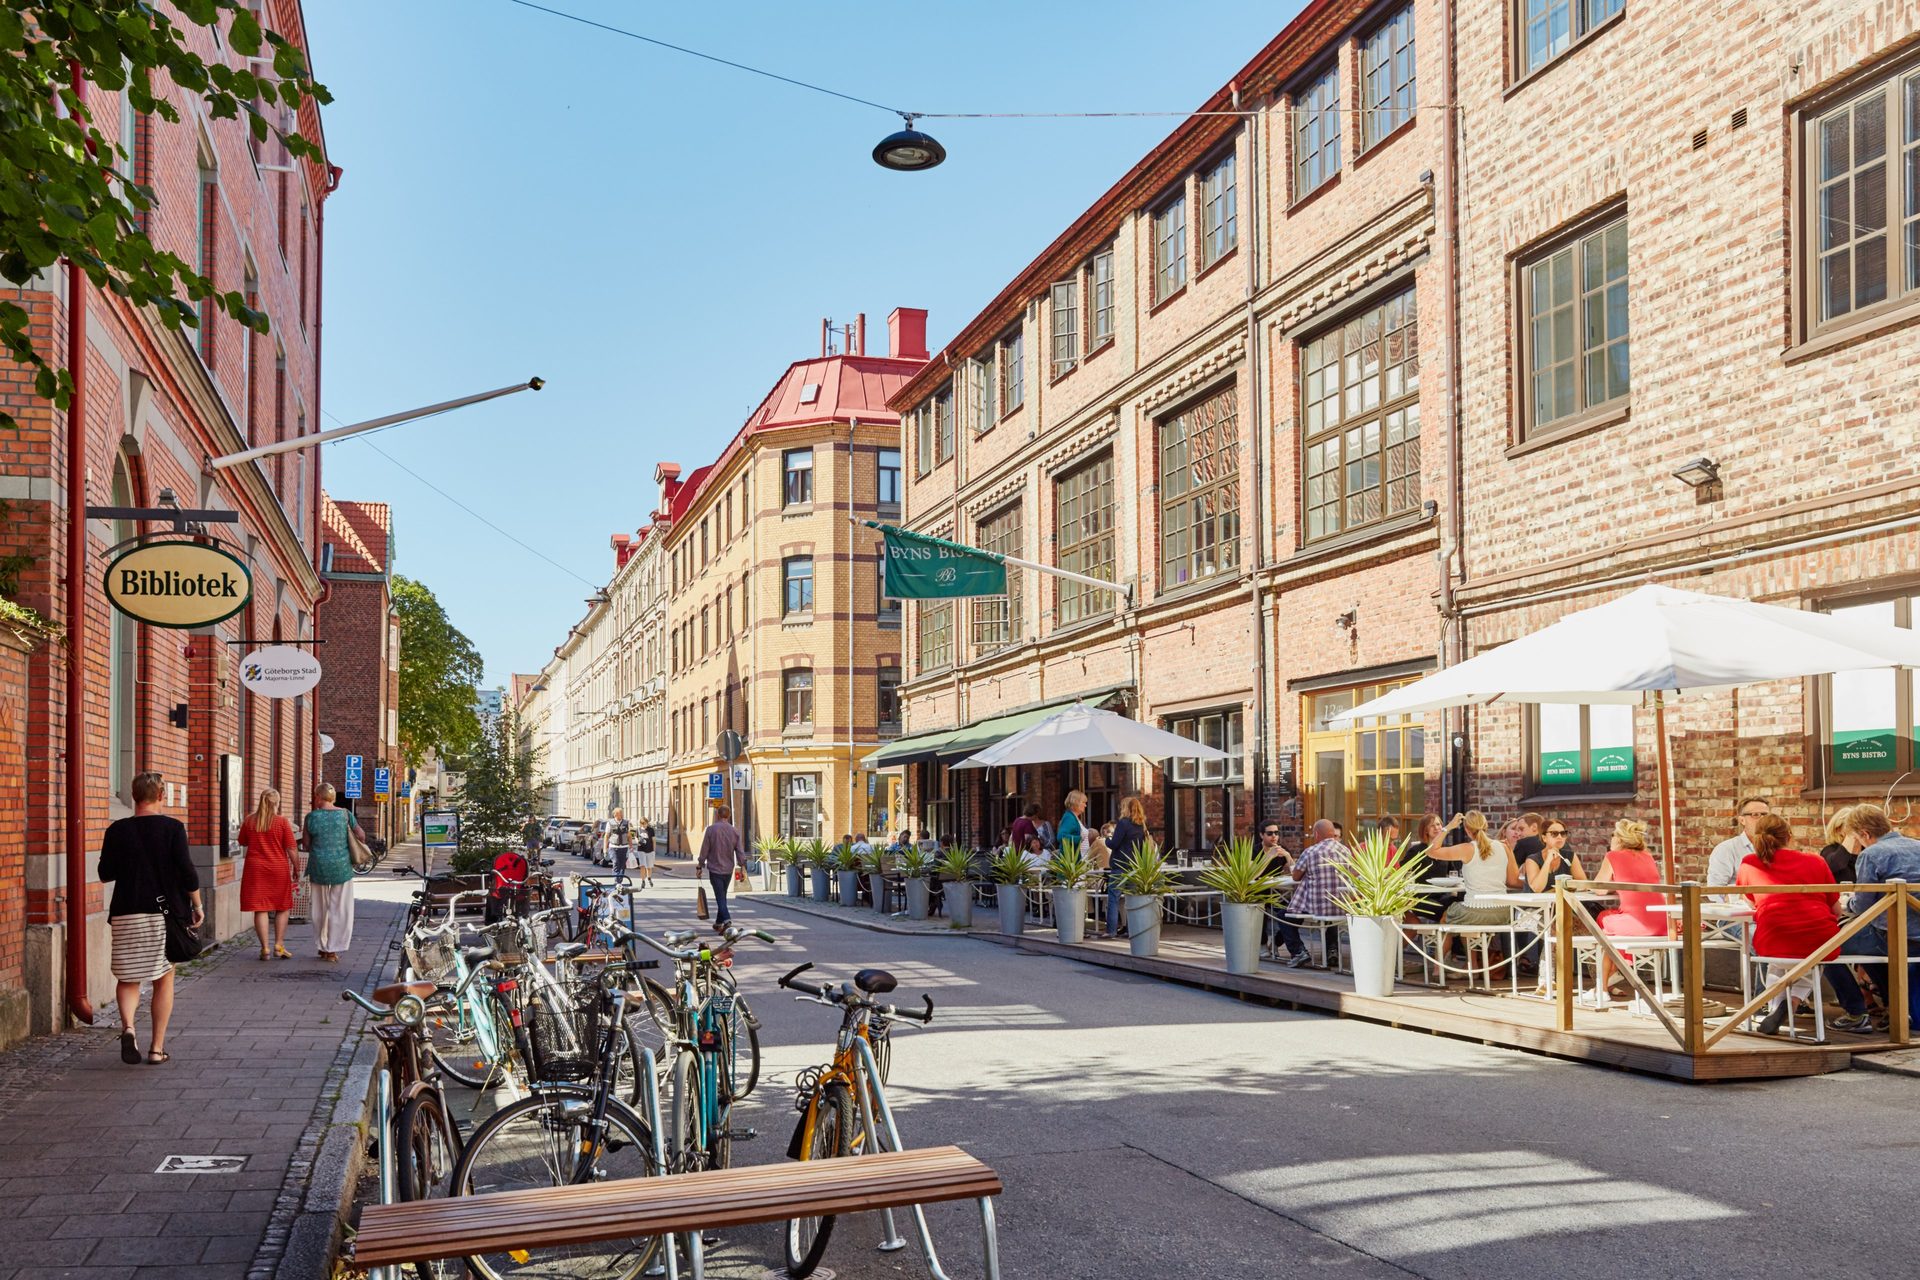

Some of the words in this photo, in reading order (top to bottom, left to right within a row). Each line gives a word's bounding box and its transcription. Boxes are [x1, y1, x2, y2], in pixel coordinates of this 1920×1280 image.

[890, 546, 932, 560] BYNS
[120, 569, 238, 598] Bibliotek
[264, 667, 300, 675] Göteborgs
[301, 666, 317, 674] Stad
[1842, 752, 1860, 760] BYNS
[1861, 750, 1887, 759] BISTRO
[350, 756, 360, 767] P
[379, 769, 387, 780] P
[712, 774, 720, 784] P
